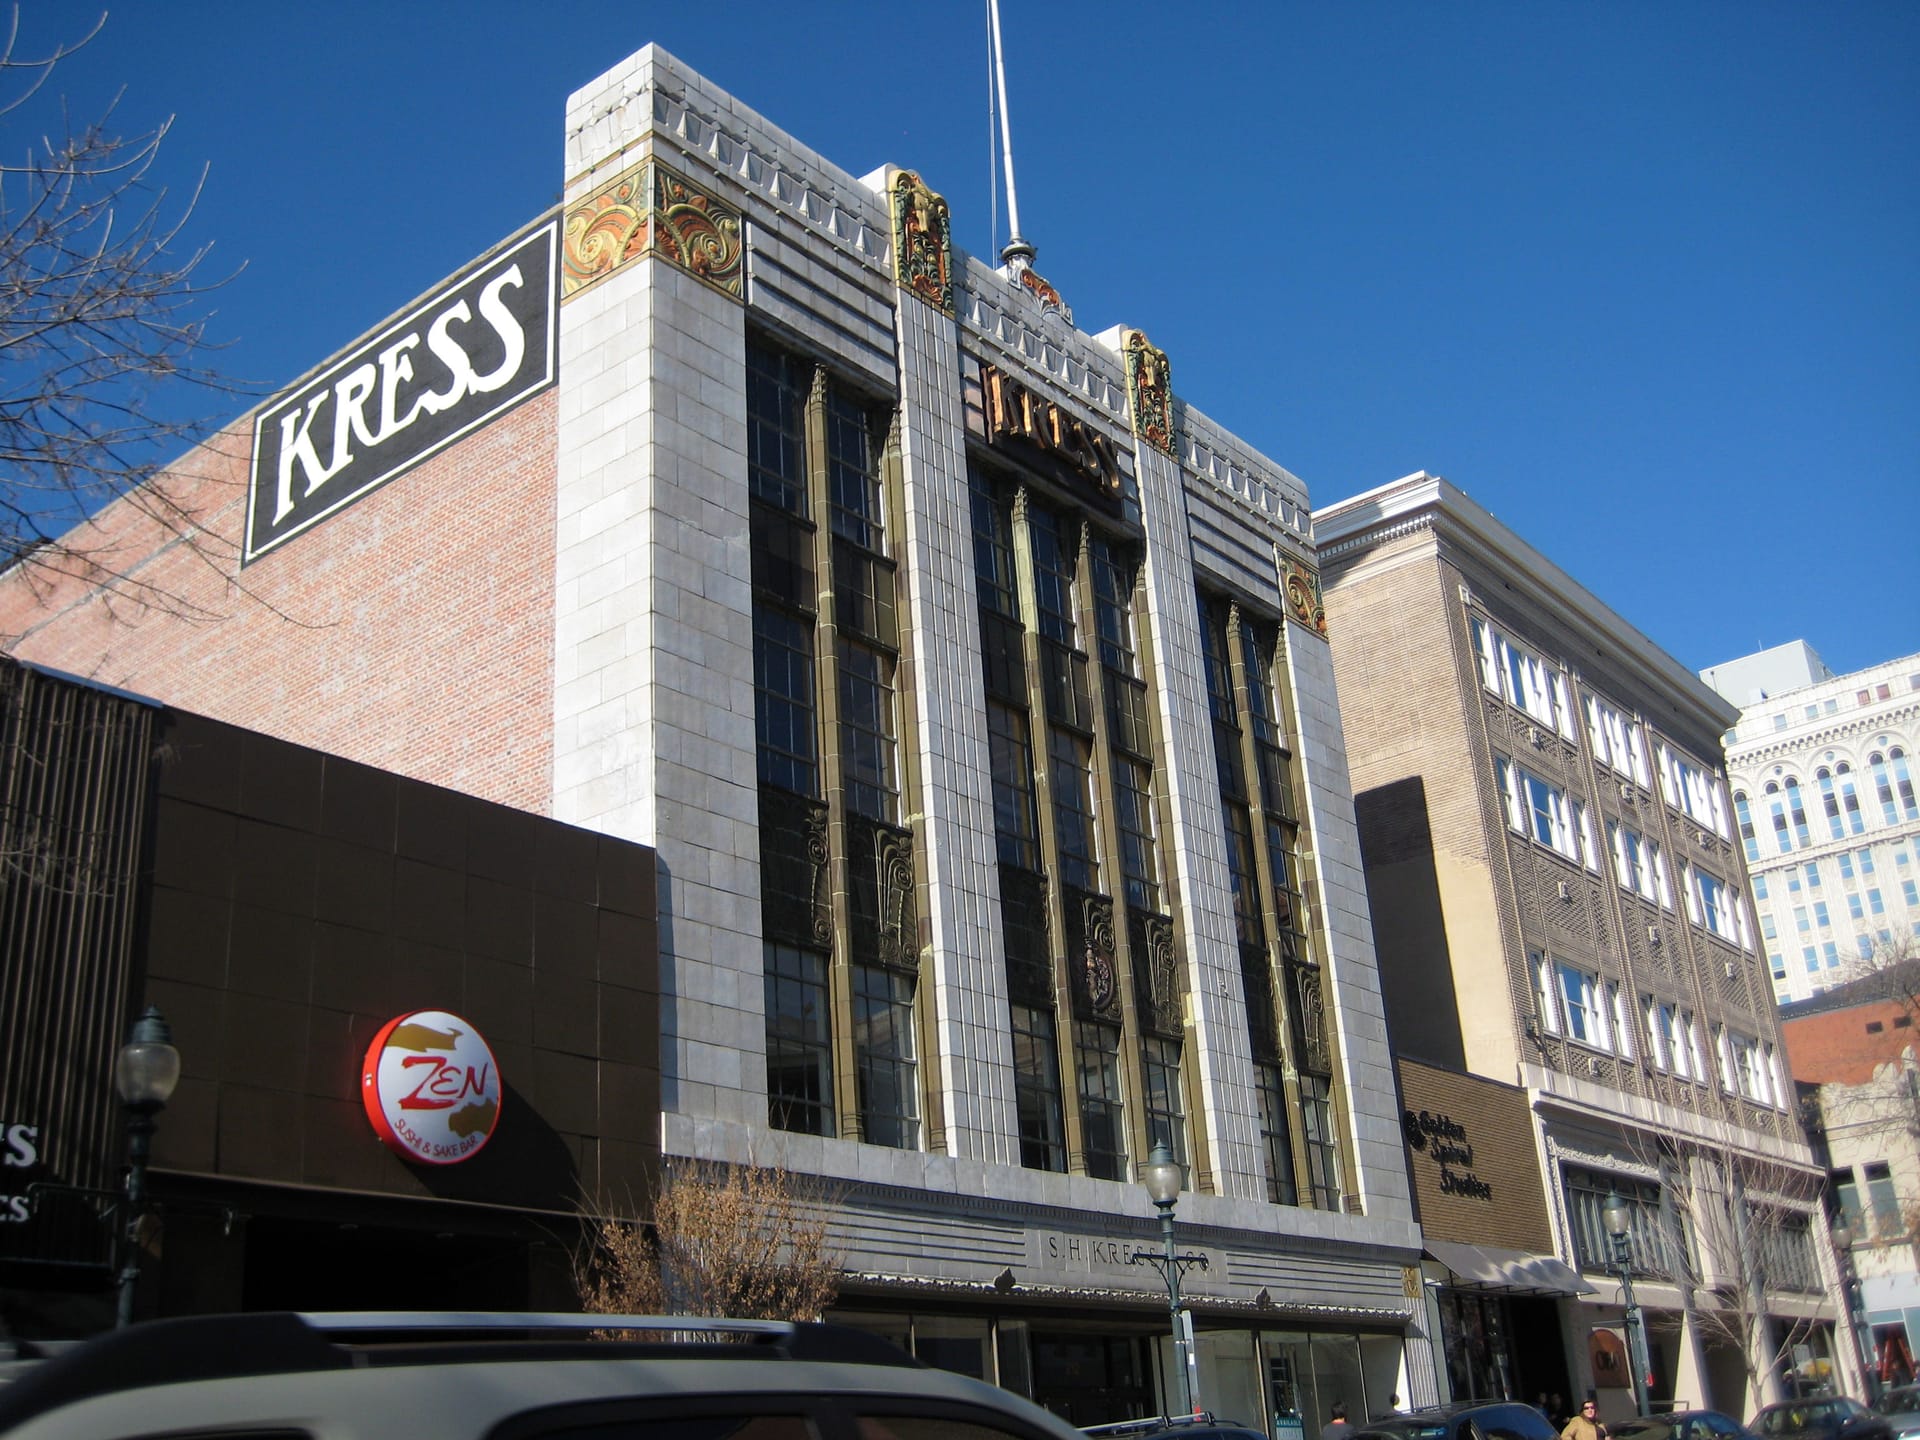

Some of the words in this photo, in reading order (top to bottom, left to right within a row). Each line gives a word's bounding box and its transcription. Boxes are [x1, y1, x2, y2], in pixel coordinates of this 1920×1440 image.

[272, 263, 525, 527] KRESS
[398, 1055, 489, 1110] ZEN
[394, 1118, 422, 1147] SUSHI
[422, 1142, 431, 1154] &
[433, 1143, 458, 1157] SAKE
[460, 1135, 478, 1153] BAR
[1093, 1240, 1157, 1267] KRESS
